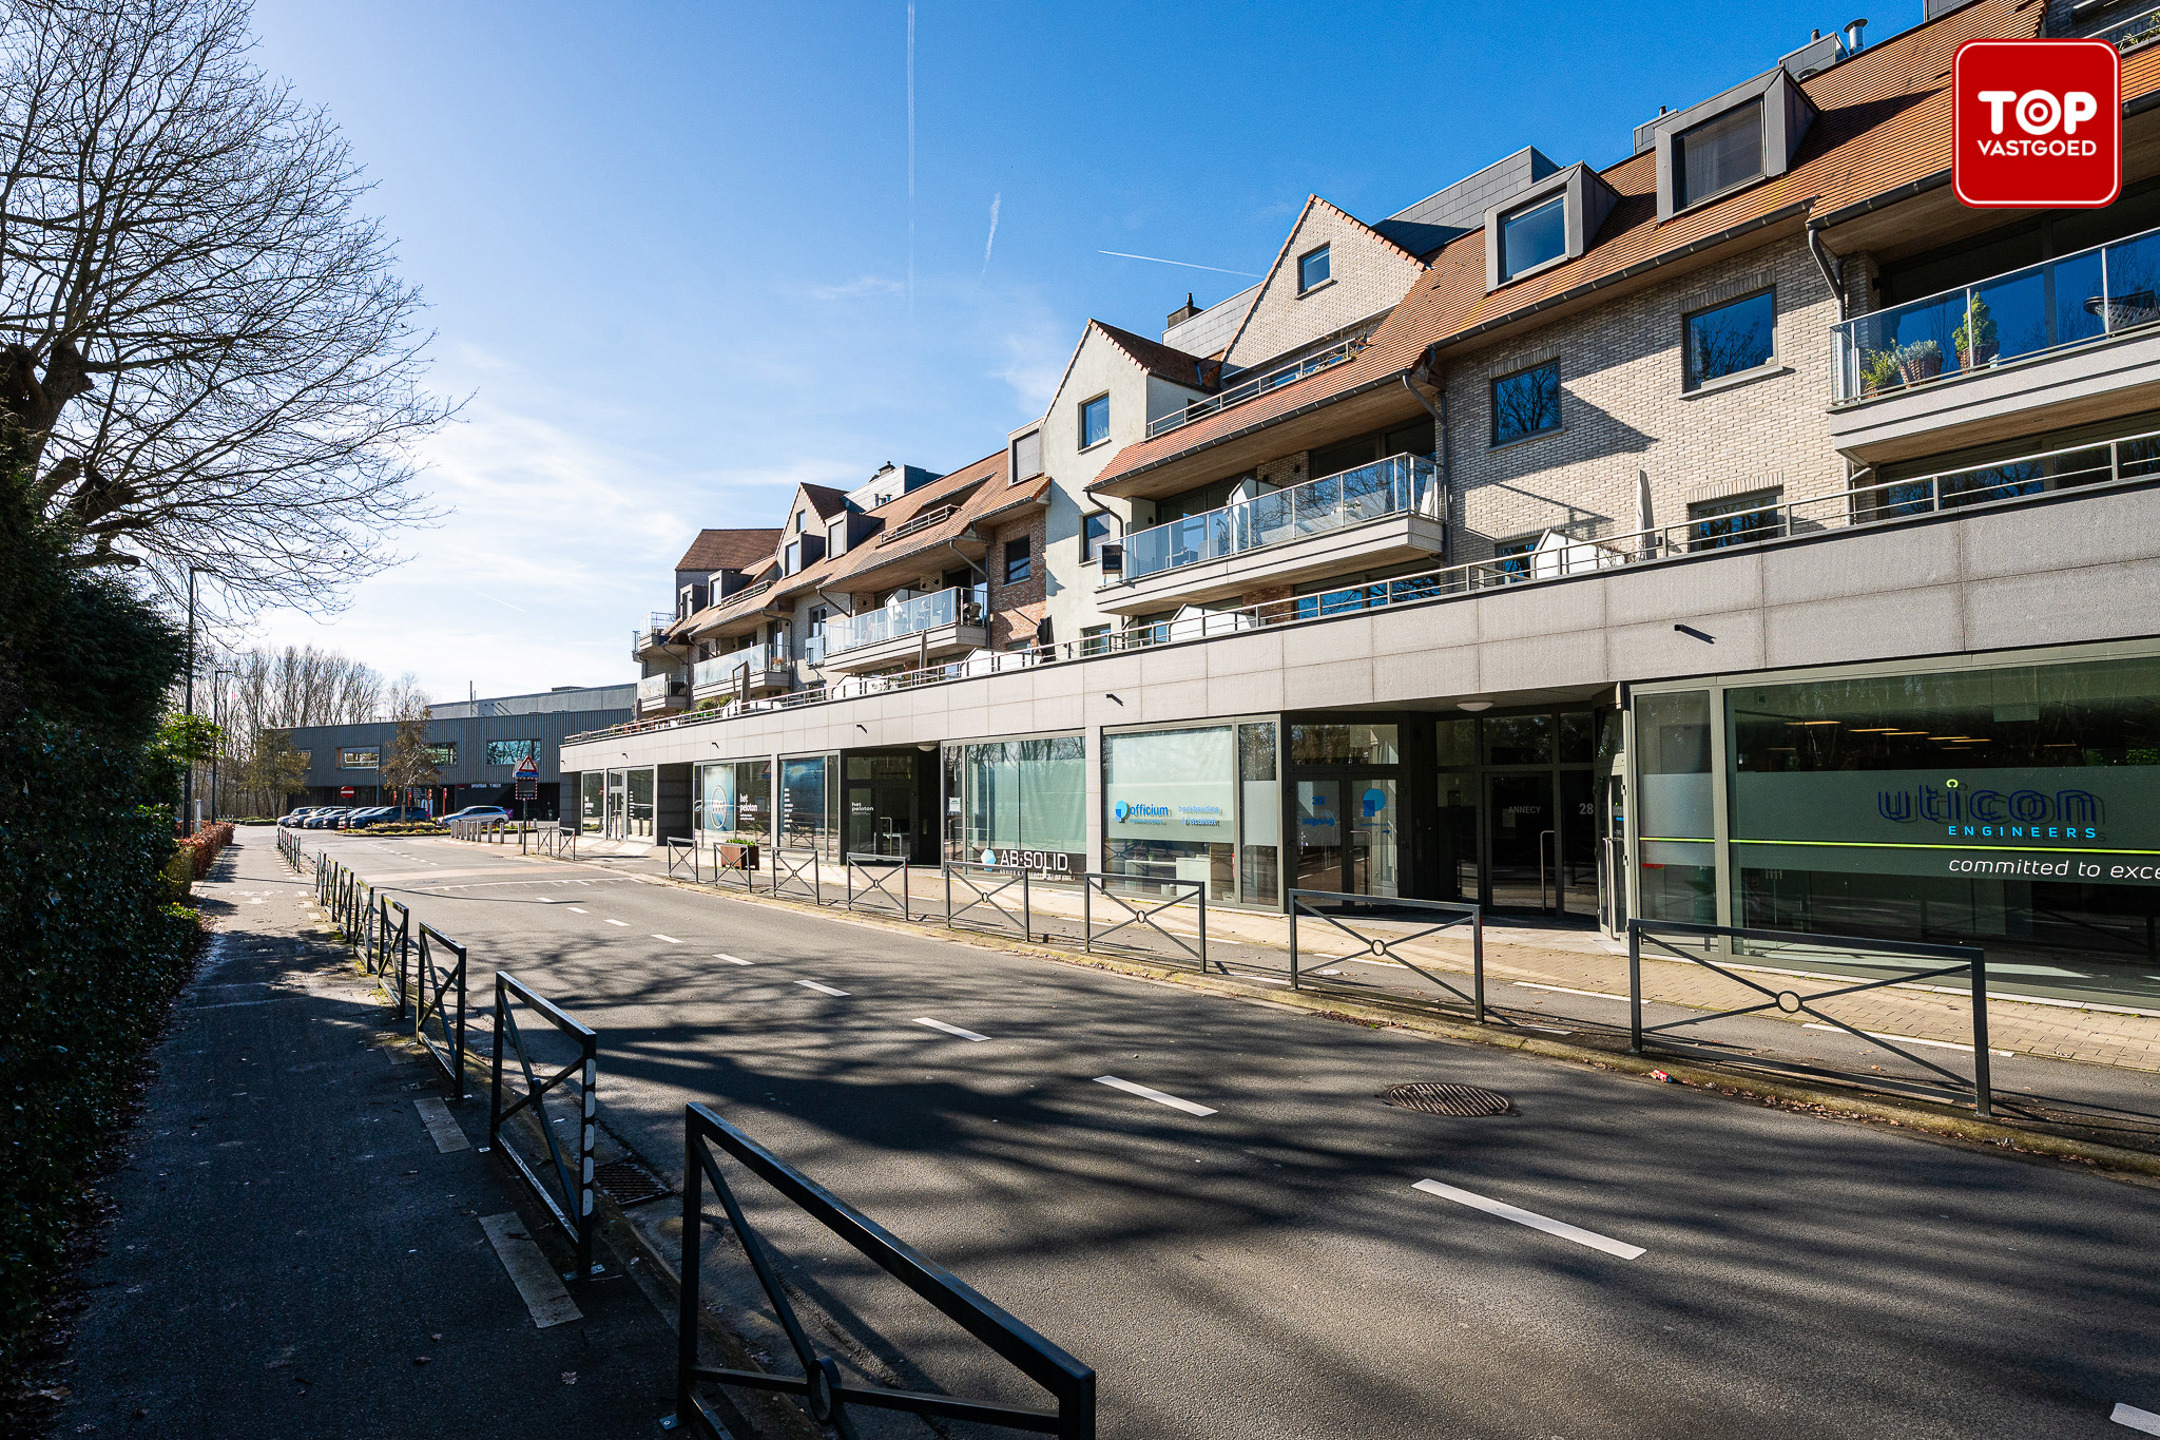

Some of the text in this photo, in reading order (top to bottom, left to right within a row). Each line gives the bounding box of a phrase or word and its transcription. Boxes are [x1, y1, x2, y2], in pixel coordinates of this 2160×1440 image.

[1311, 795, 1326, 806] 30
[1878, 778, 2096, 822] uticon
[739, 802, 758, 814] peloton
[1129, 803, 1169, 817] officium
[1507, 805, 1542, 815] ANNECY
[1578, 803, 1595, 815] 28
[1947, 825, 2097, 839] ENGINEERS
[1948, 858, 2070, 877] committed
[2077, 860, 2102, 879] to
